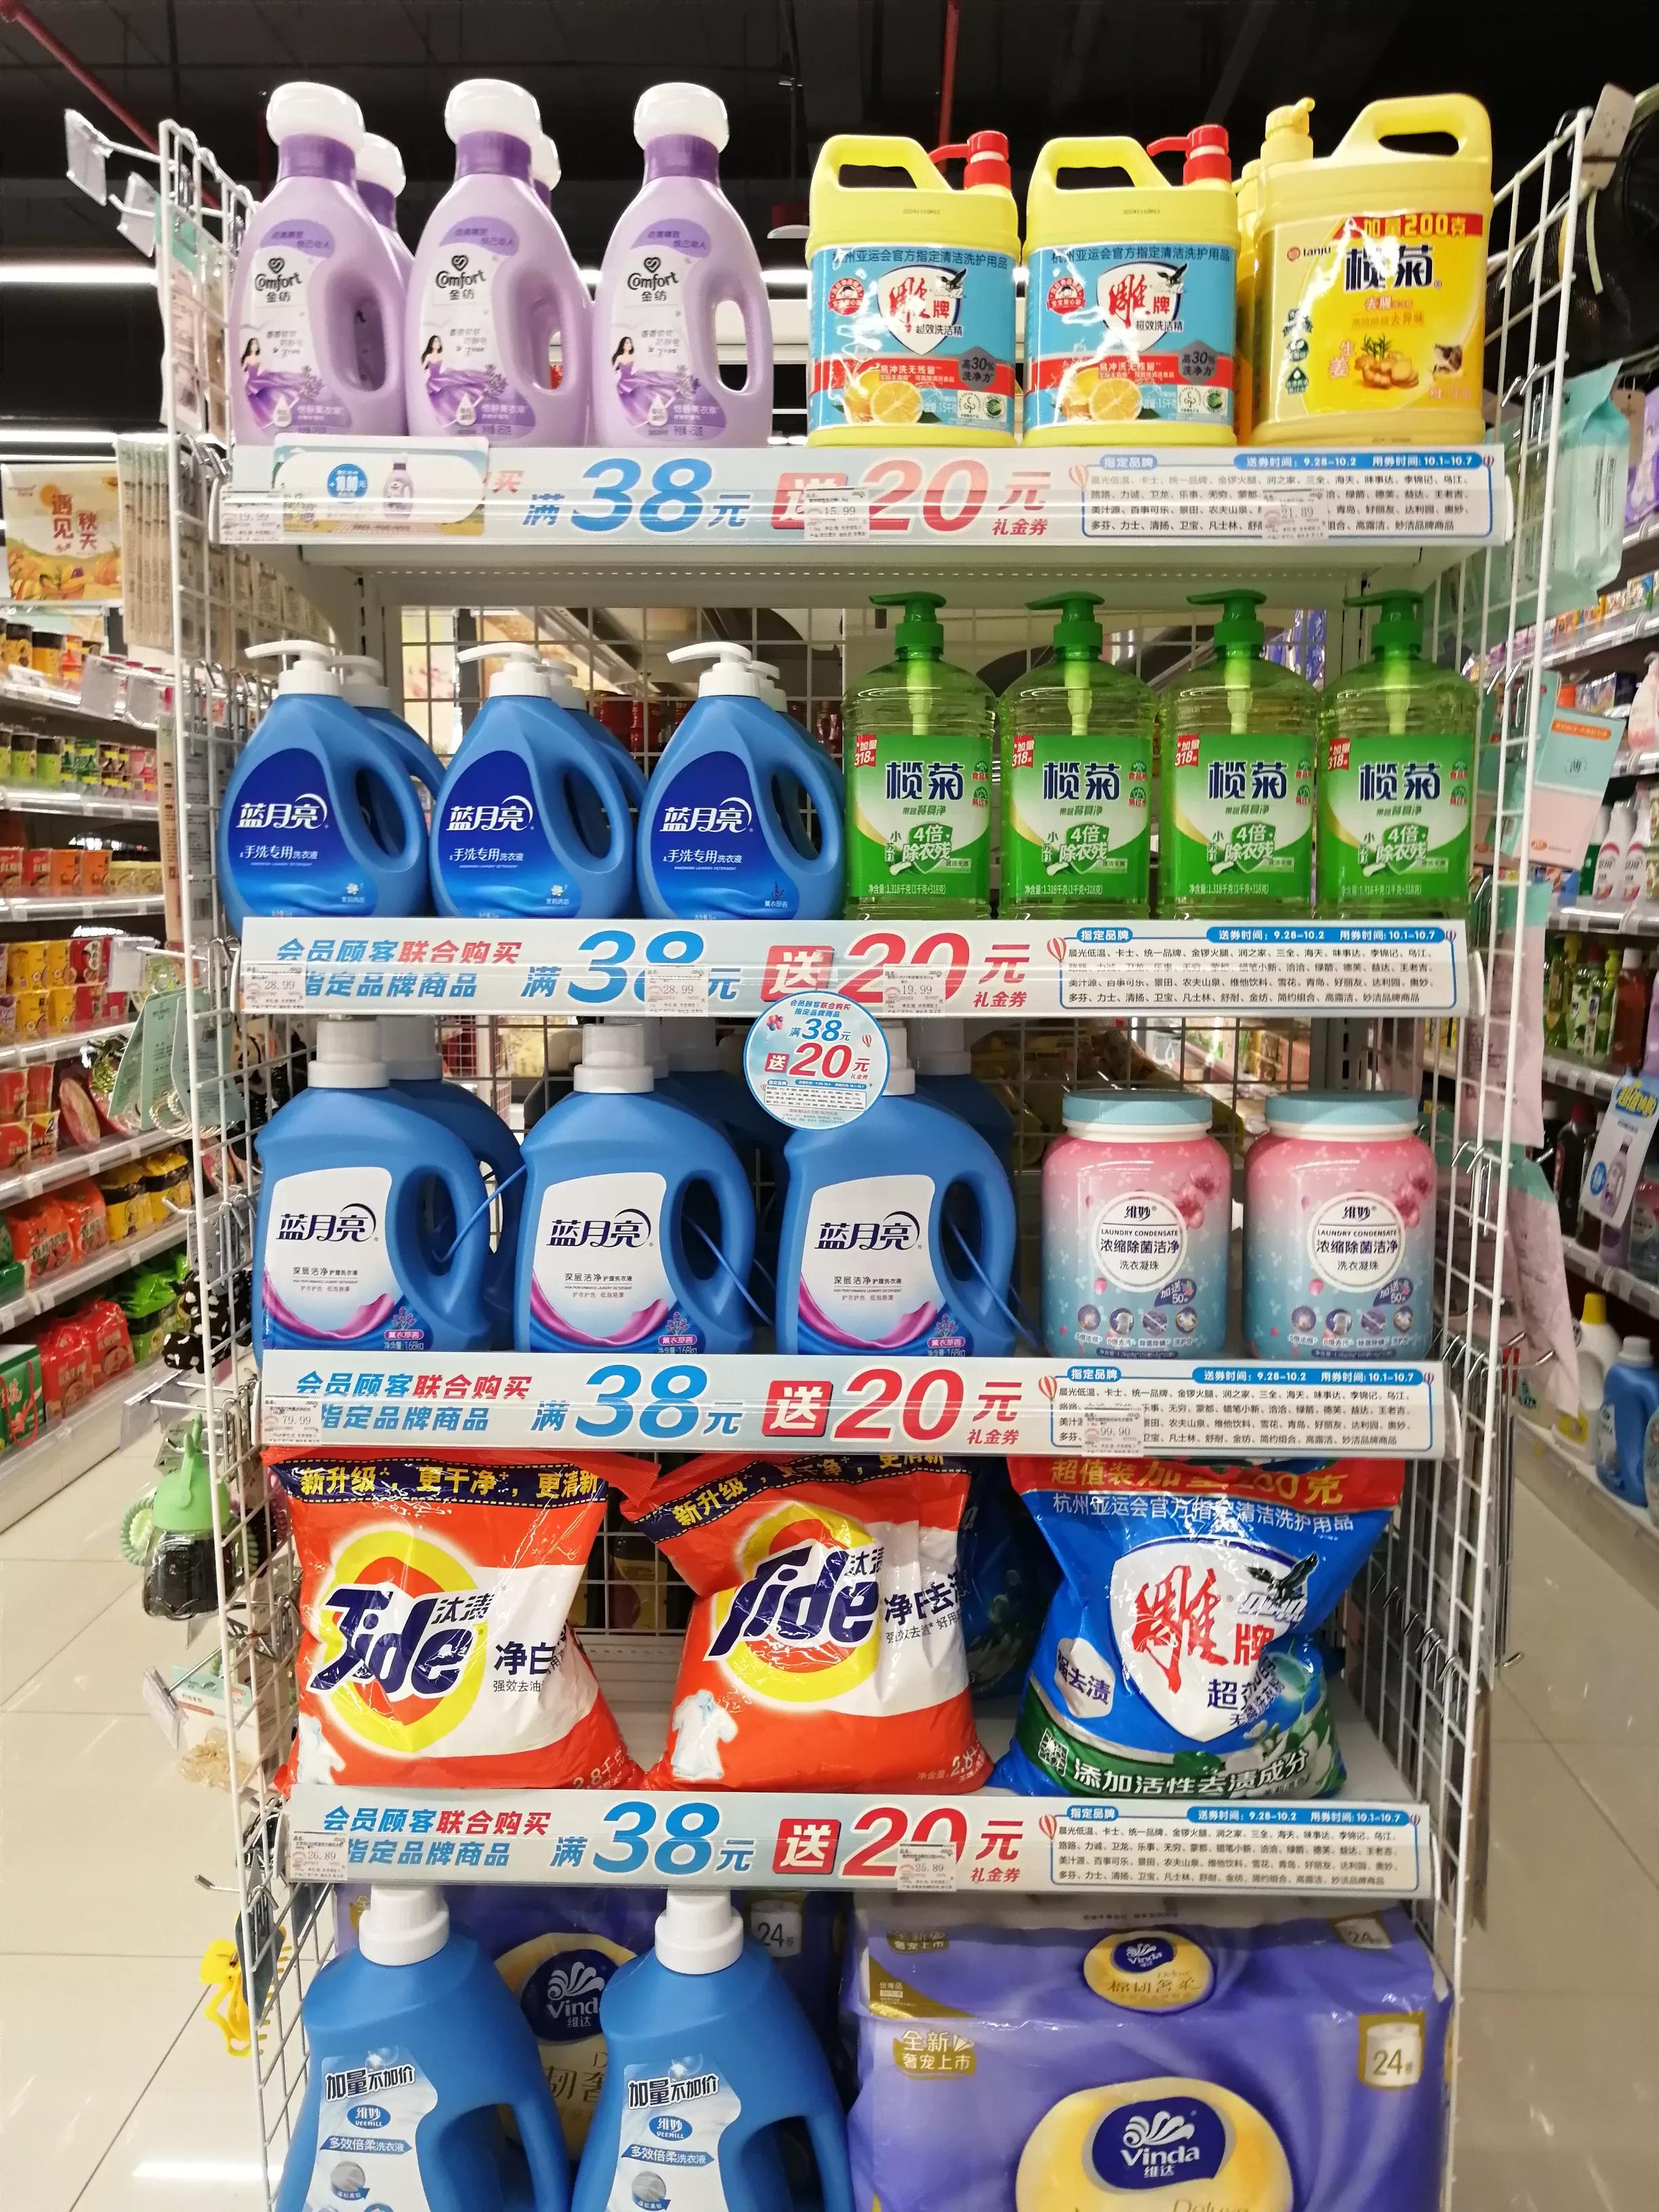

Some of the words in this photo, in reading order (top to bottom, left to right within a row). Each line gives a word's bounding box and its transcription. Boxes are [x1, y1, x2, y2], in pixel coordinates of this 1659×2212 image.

[832, 248, 1008, 270] 州亚运会官方指定清洁洗护用品
[255, 272, 302, 292] Comfort
[436, 268, 486, 290] Comfort
[628, 272, 679, 290] Comfort
[266, 291, 290, 304] 金纺
[449, 289, 474, 301] 金纺
[641, 291, 667, 302] 金纺
[1109, 274, 1170, 329] 雕牌
[916, 324, 963, 337] 超效洗洁精
[1135, 320, 1184, 332] 超效洗洁精
[1105, 456, 1154, 468] 指定品牌
[523, 457, 751, 533] 满38元
[825, 506, 856, 516] 15.99
[1281, 508, 1314, 518] 21.89
[77, 510, 98, 551] 秋天
[992, 518, 1048, 536] 礼金券
[860, 739, 878, 752] 加量
[1017, 739, 1035, 752] 加量
[885, 760, 964, 800] 榄菊
[1042, 760, 1121, 801] 榄菊
[1208, 760, 1288, 800] 榄菊
[1359, 762, 1441, 802] 榄菊
[235, 792, 329, 830] 蓝月亮
[445, 794, 533, 832] 蓝月亮
[659, 796, 752, 834] 蓝月亮
[913, 825, 944, 842] 4倍
[1069, 825, 1101, 842] 4倍
[1235, 823, 1267, 842] 4倍
[1387, 824, 1418, 842] 4倍
[242, 844, 319, 861] 手洗专用洗衣液
[453, 846, 524, 863] 手洗专用洗衣液
[666, 848, 743, 865] 手洗专用洗衣液
[901, 842, 953, 863] 除农残
[1058, 842, 1110, 862] 除农残
[1224, 842, 1275, 862] 除农残
[1375, 842, 1427, 863] 除农残
[1081, 929, 1129, 941] 指定品牌
[276, 937, 523, 965] 会员顾客联合购买
[305, 970, 478, 998] 指定品牌商品
[663, 984, 694, 994] 28.99
[903, 984, 933, 995] 19.99
[790, 999, 852, 1011] 会员顾客联合购买
[972, 991, 1027, 1008] 礼金券
[794, 1008, 840, 1018] 指定品牌商品
[788, 1018, 852, 1042] 满38元
[766, 1042, 871, 1079] 送20元
[276, 1202, 377, 1243] 蓝月亮
[1124, 1205, 1151, 1222] 维妙
[1342, 1206, 1371, 1222] 维妙
[546, 1208, 652, 1248] 蓝月亮
[814, 1210, 921, 1251] 蓝月亮
[1101, 1229, 1132, 1237] LAUNDRY
[1134, 1229, 1179, 1237] CONDENSATE
[1317, 1229, 1351, 1237] LAUNDRY
[1353, 1229, 1397, 1237] CONDENSATE
[1100, 1238, 1180, 1254] 浓缩除菌洁净
[1316, 1240, 1399, 1254] 浓缩除菌洁净
[1120, 1260, 1160, 1271] 洗衣凝珠
[1337, 1261, 1378, 1271] 洗衣凝珠
[388, 1330, 420, 1340] 薰衣草香
[661, 1335, 694, 1345] 薰衣草香
[930, 1338, 962, 1347] 薰衣草香
[1070, 1368, 1118, 1380] 指定品牌
[295, 1370, 533, 1400] 会员顾客联合购买
[530, 1364, 743, 1439] 满38元
[769, 1368, 1023, 1441] 送20元
[282, 1416, 312, 1425] 79.99
[321, 1405, 491, 1431] 指定品牌商品
[966, 1428, 1020, 1446] 礼金券
[538, 1469, 600, 1500] 更清新
[1052, 1493, 1354, 1533] 杭州亚运会官方指定清洁洗护用品
[709, 1545, 879, 1658] Tide
[308, 1588, 475, 1696] Tide
[1073, 1749, 1309, 1795] 添加活性去渍成分
[323, 1805, 553, 1836] 会员顾客联合购买
[1070, 1807, 1115, 1821] 指定品牌
[549, 1800, 755, 1875] 满38元
[307, 1851, 337, 1860] 26.89
[348, 1839, 512, 1867] 指定品牌商品
[970, 1867, 1021, 1883] 礼金券
[1127, 1951, 1163, 1965] Vinda
[546, 1996, 598, 2020] Vind
[567, 2015, 592, 2028] 维达
[902, 2030, 950, 2052] 全新
[903, 2053, 970, 2070] 奢宠上市
[325, 2064, 416, 2103] 加量不加价
[628, 2073, 720, 2110] 加量不加价
[354, 2106, 382, 2122] 维妙
[657, 2117, 683, 2131] 维妙
[329, 2136, 405, 2153] 多效倍柔洗衣液
[630, 2146, 707, 2165] 多效倍柔洗衣液
[1121, 2146, 1200, 2166] Vinda
[1144, 2163, 1175, 2178] 维达
